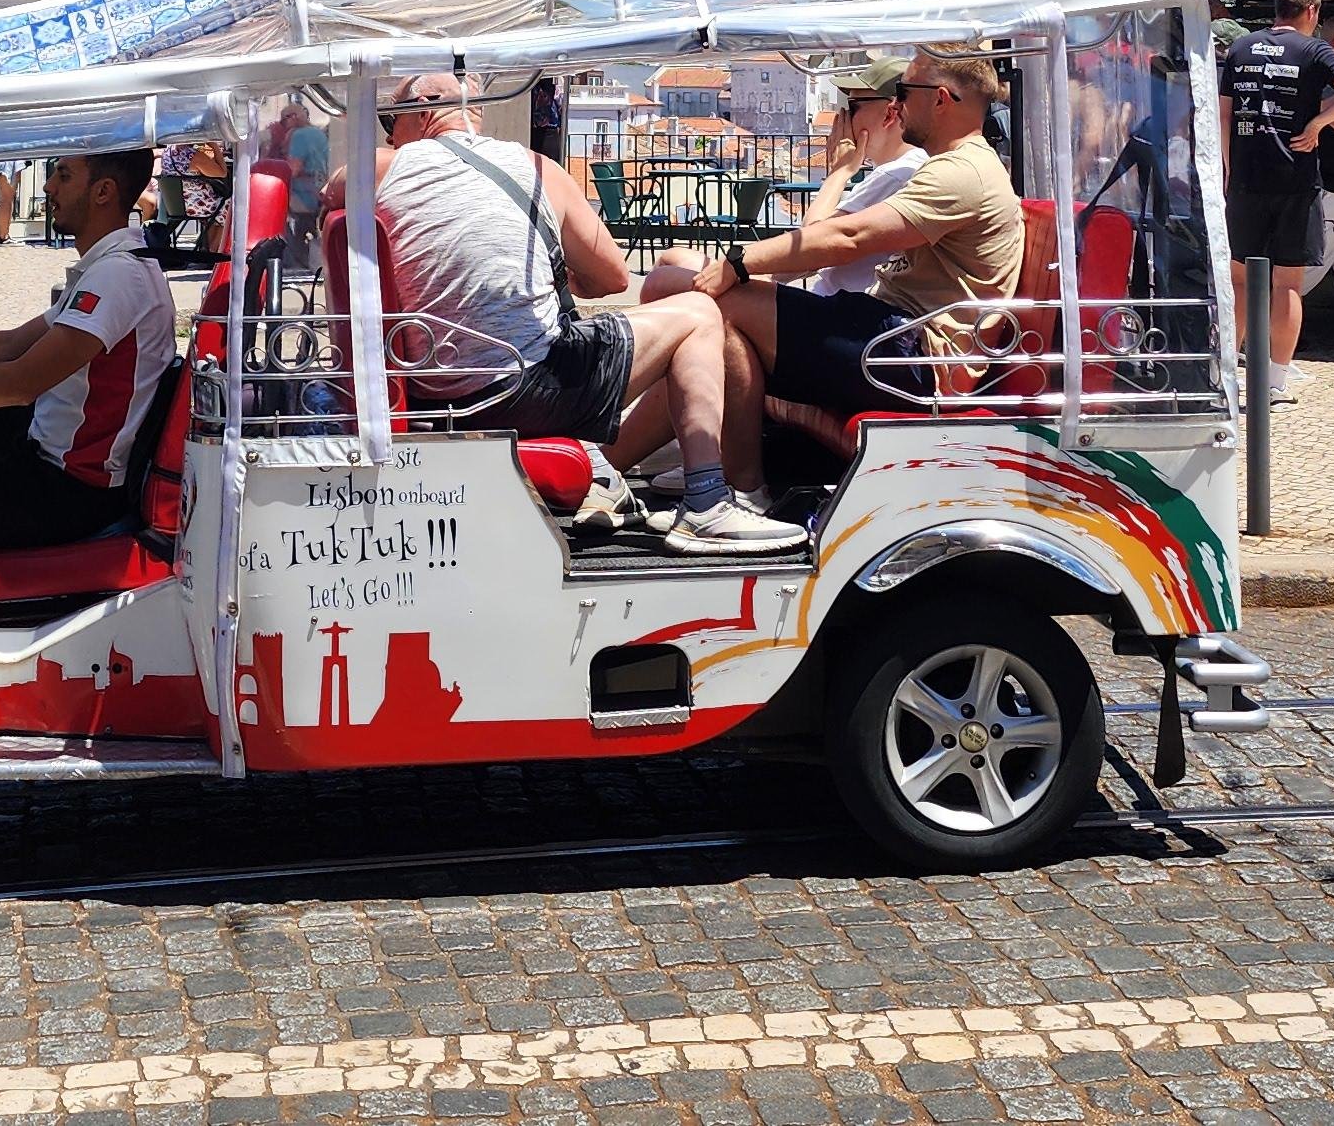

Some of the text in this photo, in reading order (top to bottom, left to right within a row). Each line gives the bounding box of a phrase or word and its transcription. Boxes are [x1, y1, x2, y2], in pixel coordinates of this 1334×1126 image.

[305, 471, 466, 510] Lisbon onboard
[307, 576, 354, 611] Let's
